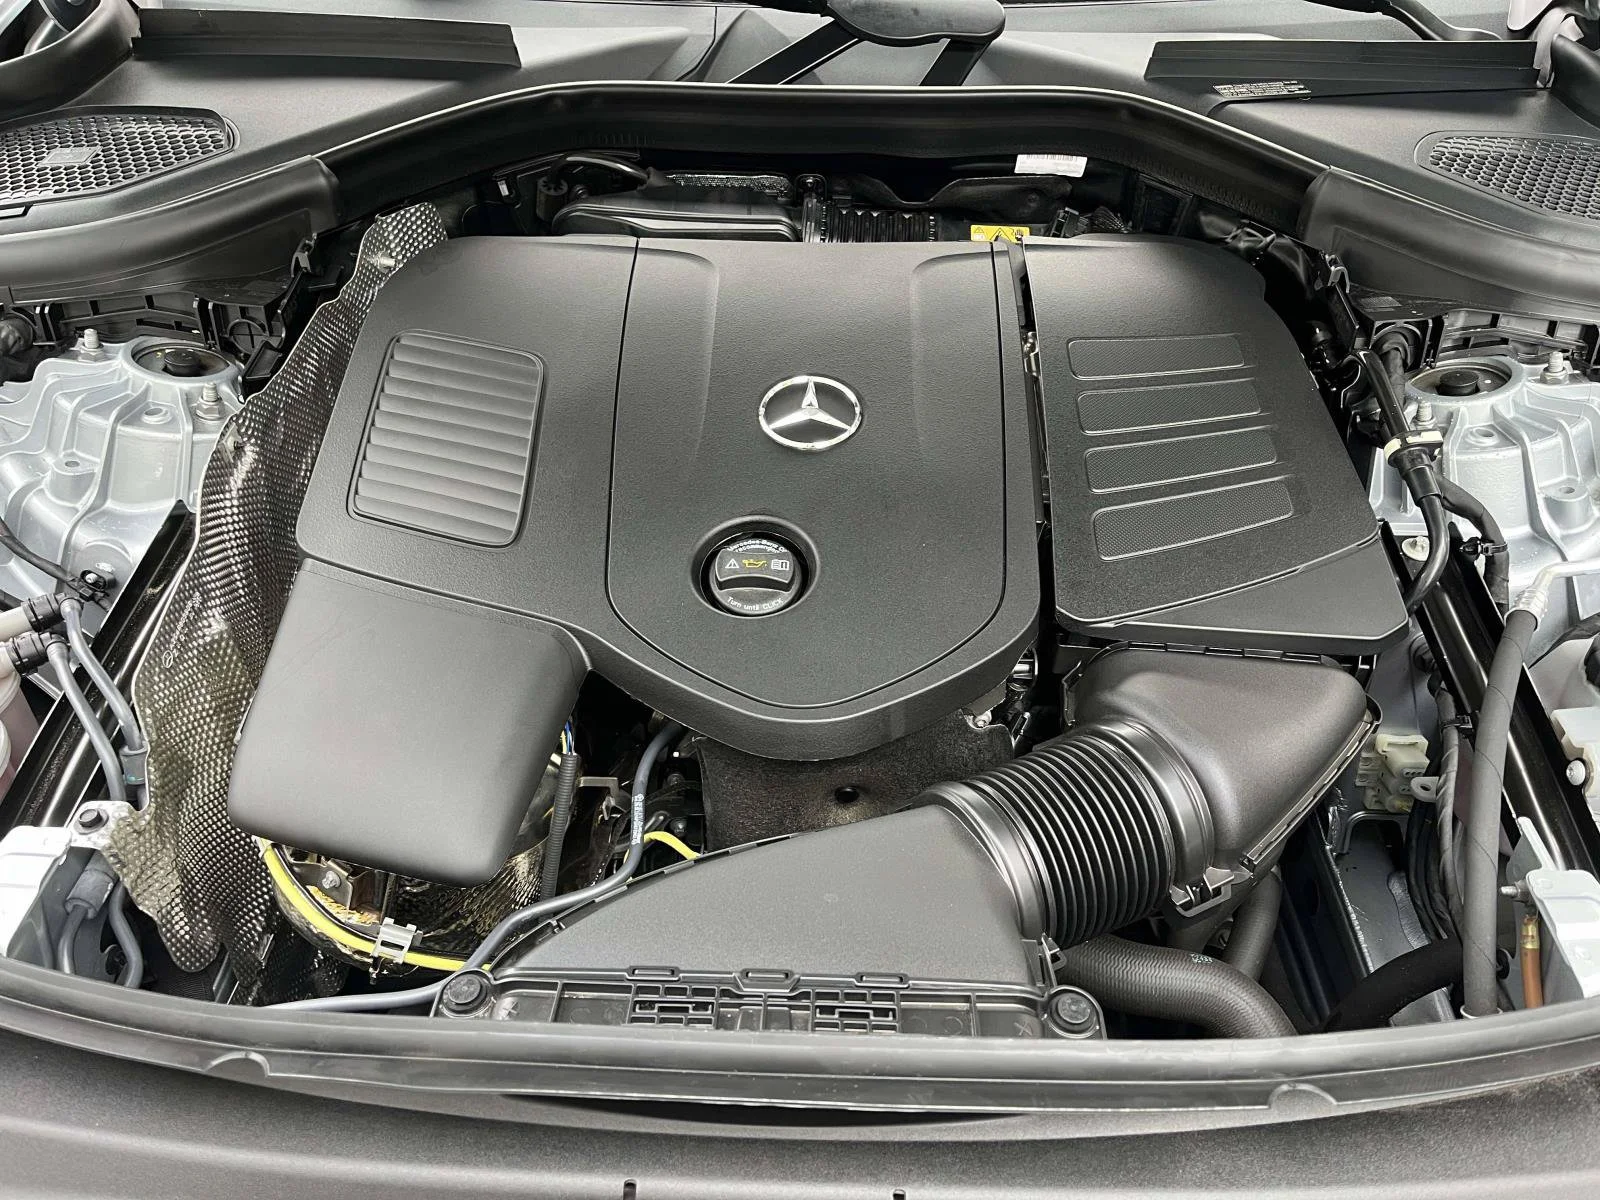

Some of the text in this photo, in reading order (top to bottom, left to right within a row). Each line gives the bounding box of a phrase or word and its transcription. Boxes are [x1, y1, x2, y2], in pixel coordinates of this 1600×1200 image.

[727, 597, 784, 611] Turn until CLICK
